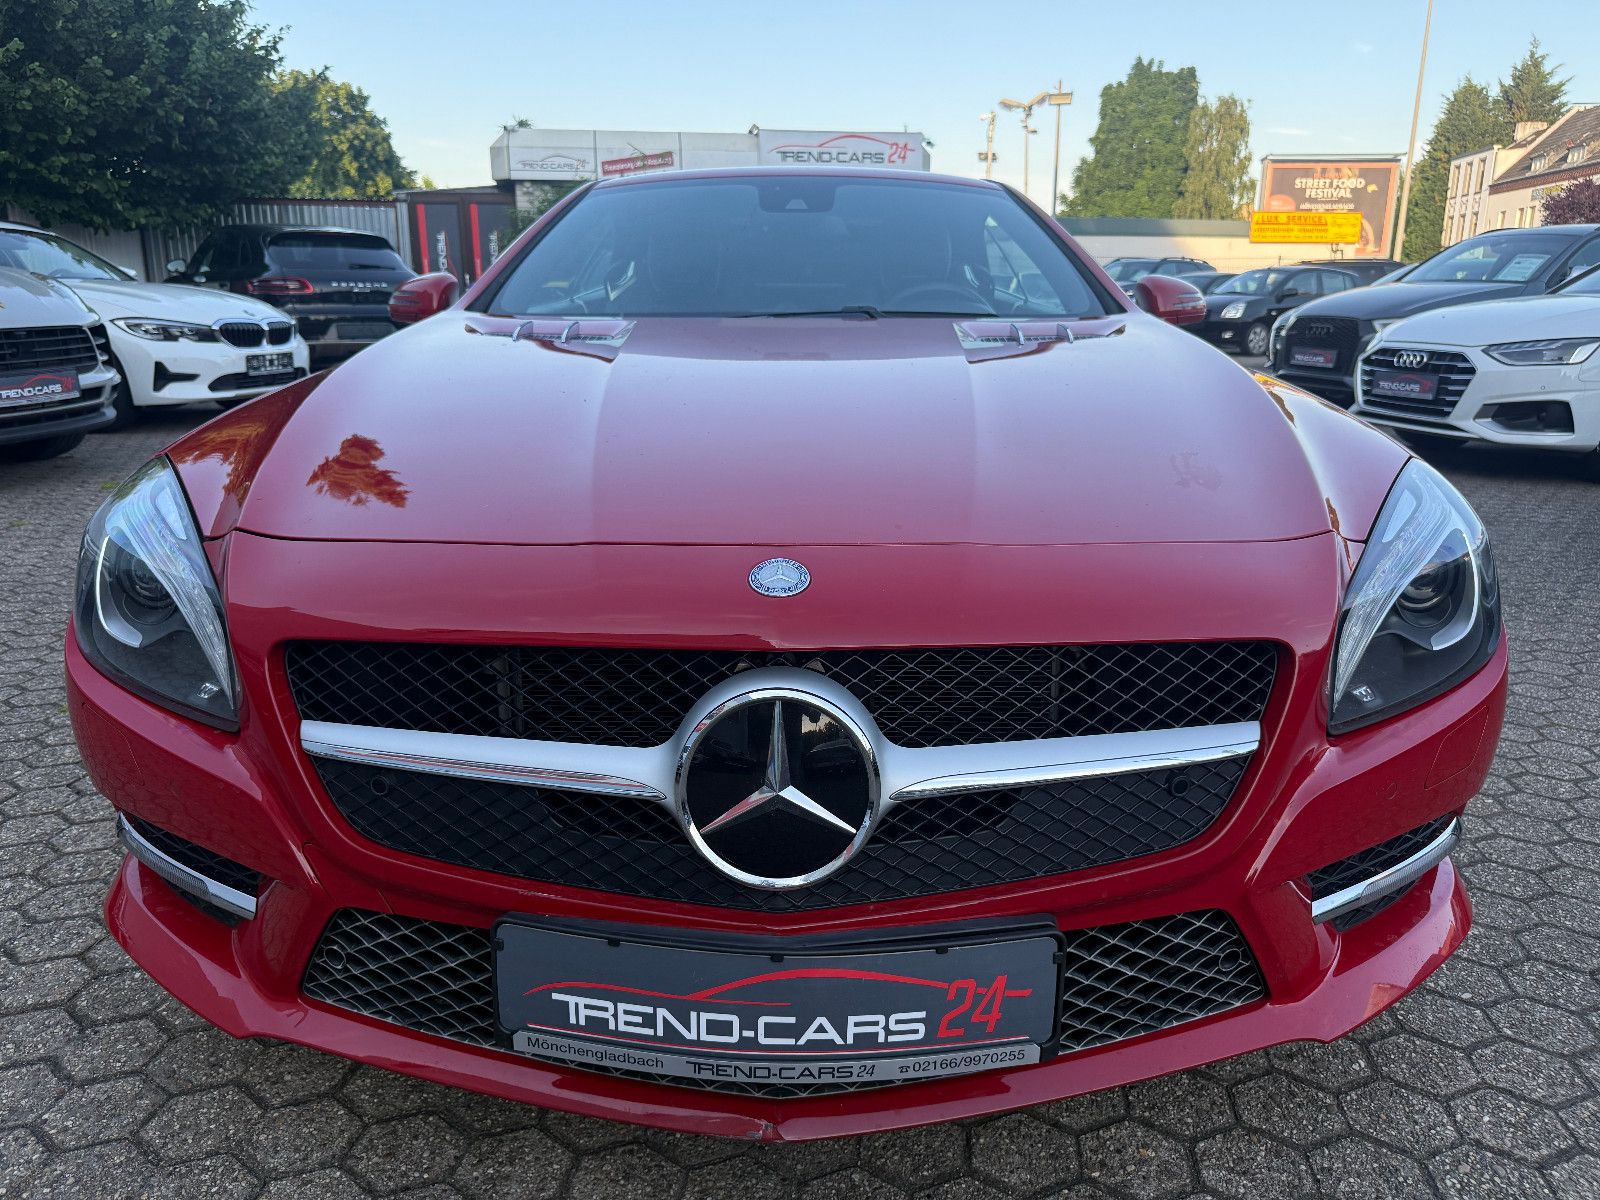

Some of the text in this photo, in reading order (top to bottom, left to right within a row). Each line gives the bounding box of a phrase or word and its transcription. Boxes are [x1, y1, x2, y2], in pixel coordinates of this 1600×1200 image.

[776, 141, 909, 164] TREND-CARS 24
[1294, 177, 1366, 189] STREET FOOD
[1305, 188, 1352, 199] FESTIVAL
[551, 975, 1009, 1045] TREND-CARS 24
[526, 1036, 665, 1070] Mönchengladbach
[911, 1048, 1026, 1074] 02166/9970255
[685, 1059, 877, 1081] TREND-CARS 24
